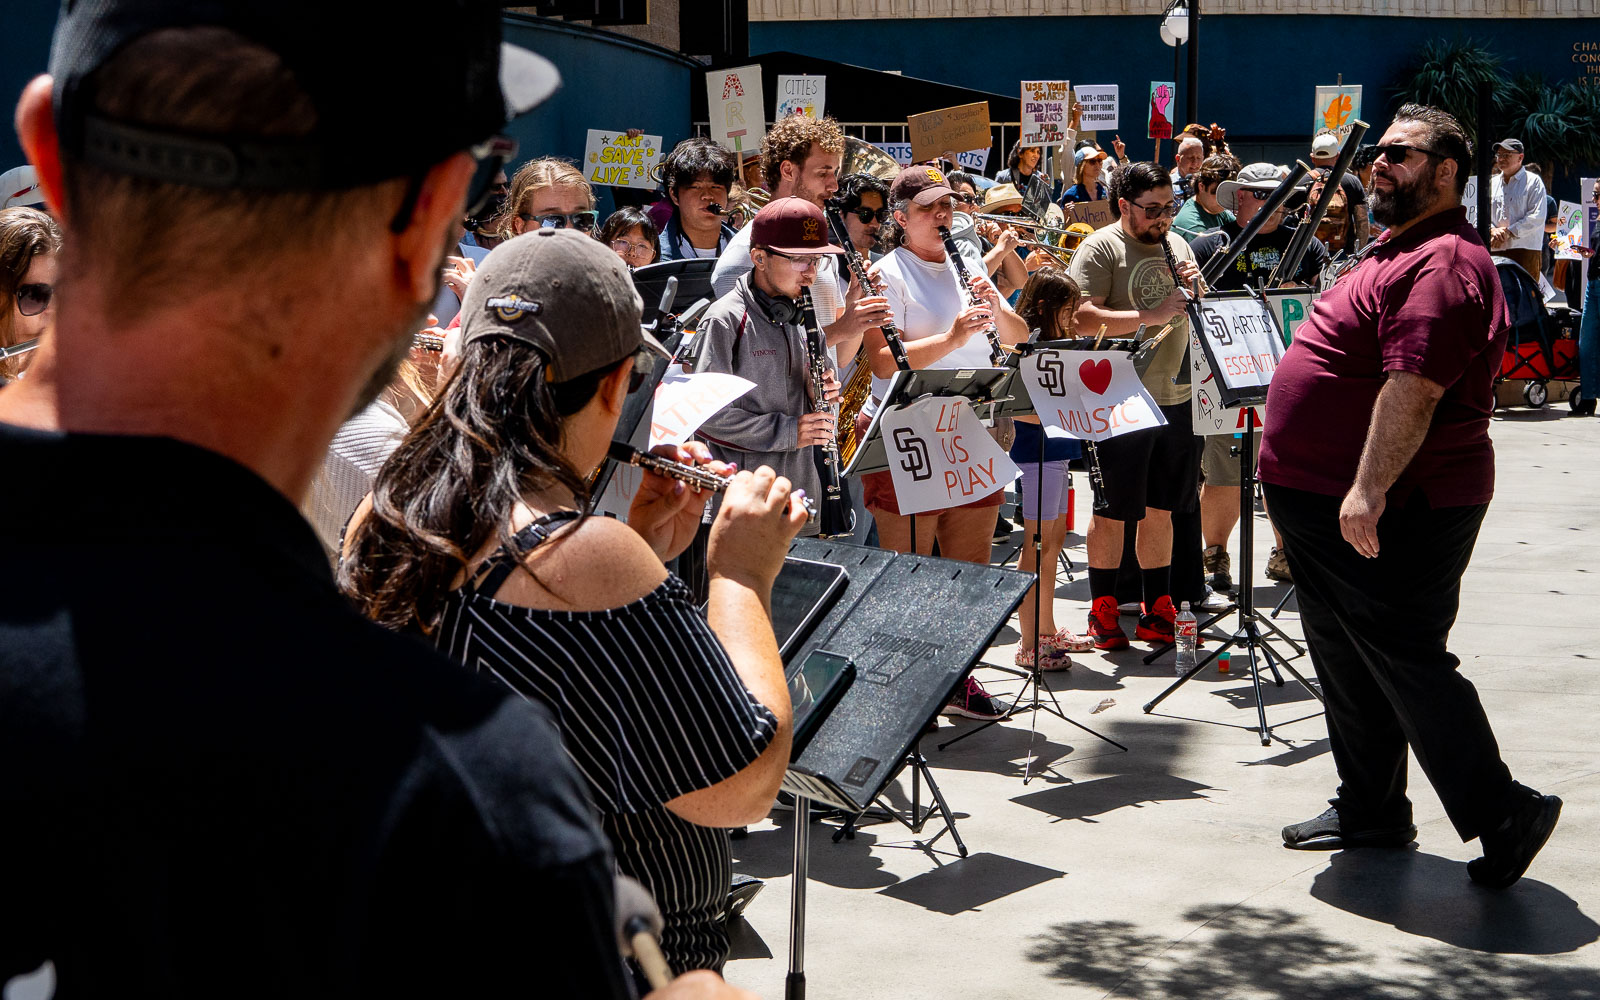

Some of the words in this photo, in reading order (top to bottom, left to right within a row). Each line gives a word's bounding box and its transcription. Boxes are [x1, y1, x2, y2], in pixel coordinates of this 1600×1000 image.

[785, 79, 818, 96] CITIES
[1025, 82, 1043, 91] USE
[1046, 82, 1067, 91] YOUR
[1033, 91, 1065, 101] SMARTS
[1080, 94, 1093, 102] ARTS
[1097, 94, 1116, 102] CULTURE
[1025, 103, 1044, 113] FIND
[1044, 102, 1063, 112] YOUR
[1034, 112, 1063, 122] HEARTS
[1088, 113, 1116, 121] PROPAGANDA
[1025, 132, 1044, 143] THE
[1045, 132, 1065, 143] ARTS
[1073, 206, 1107, 223] When
[1233, 315, 1257, 335] ART
[1257, 315, 1273, 333] IS
[936, 401, 962, 432] LET
[1057, 402, 1139, 434] MUSIC
[942, 436, 969, 465] US
[944, 458, 997, 499] PLAY
